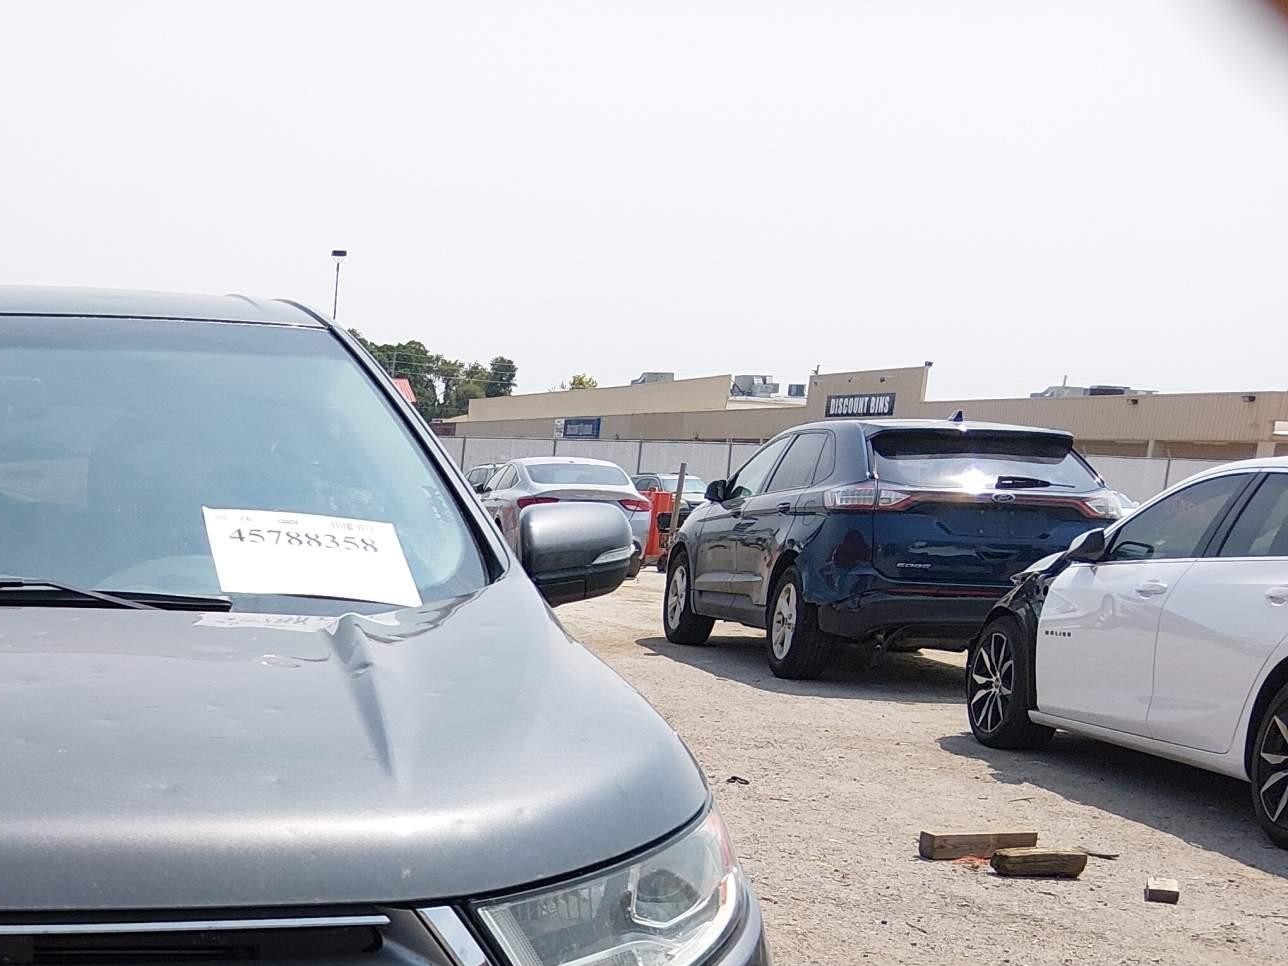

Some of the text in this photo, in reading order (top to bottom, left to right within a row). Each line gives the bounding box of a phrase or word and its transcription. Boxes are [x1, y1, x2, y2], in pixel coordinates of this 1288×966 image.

[829, 396, 890, 414] DISCOUNT BINS
[228, 527, 379, 553] 45788358
